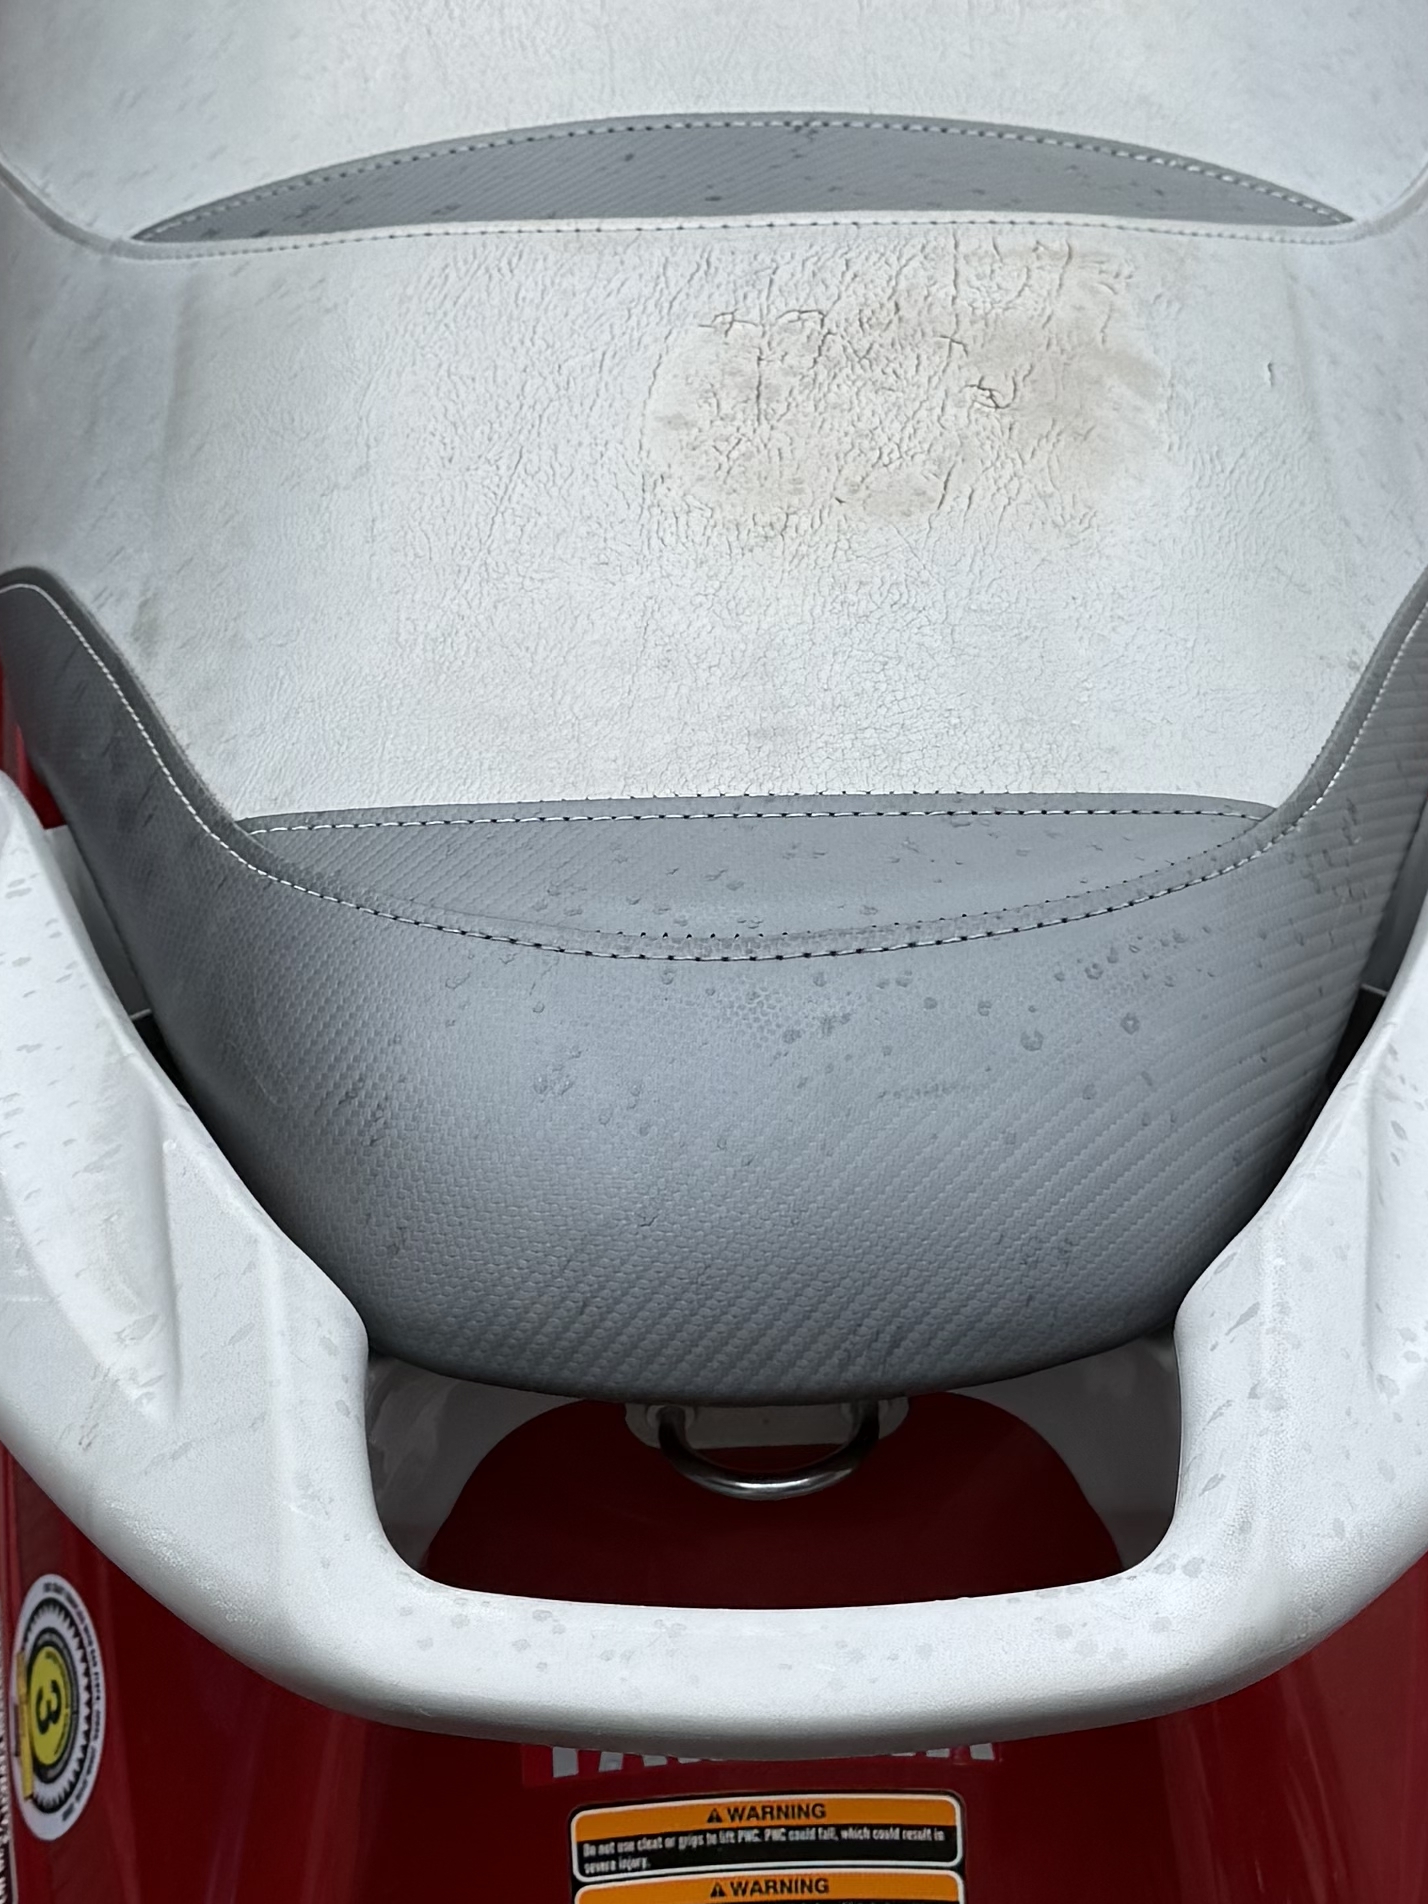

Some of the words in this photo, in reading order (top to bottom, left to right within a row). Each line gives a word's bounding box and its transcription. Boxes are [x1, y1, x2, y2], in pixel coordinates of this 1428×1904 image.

[35, 1679, 63, 1736] 3
[727, 1803, 826, 1823] WARNING
[583, 1843, 596, 1857] Do
[598, 1842, 615, 1855] not
[617, 1841, 635, 1853] use
[637, 1836, 663, 1851] cleat
[665, 1837, 676, 1848] or
[678, 1834, 704, 1850] grips
[706, 1832, 717, 1845] to
[719, 1829, 735, 1843] lift
[737, 1829, 761, 1843] PWC.
[764, 1827, 787, 1841] PWC
[788, 1827, 816, 1841] could
[818, 1827, 839, 1841] fall,
[841, 1826, 870, 1840] which
[872, 1827, 900, 1840] could
[902, 1828, 932, 1841] result
[933, 1829, 945, 1841] in
[584, 1860, 616, 1875] severe
[618, 1856, 651, 1872] injury.
[730, 1878, 829, 1897] WARNING
